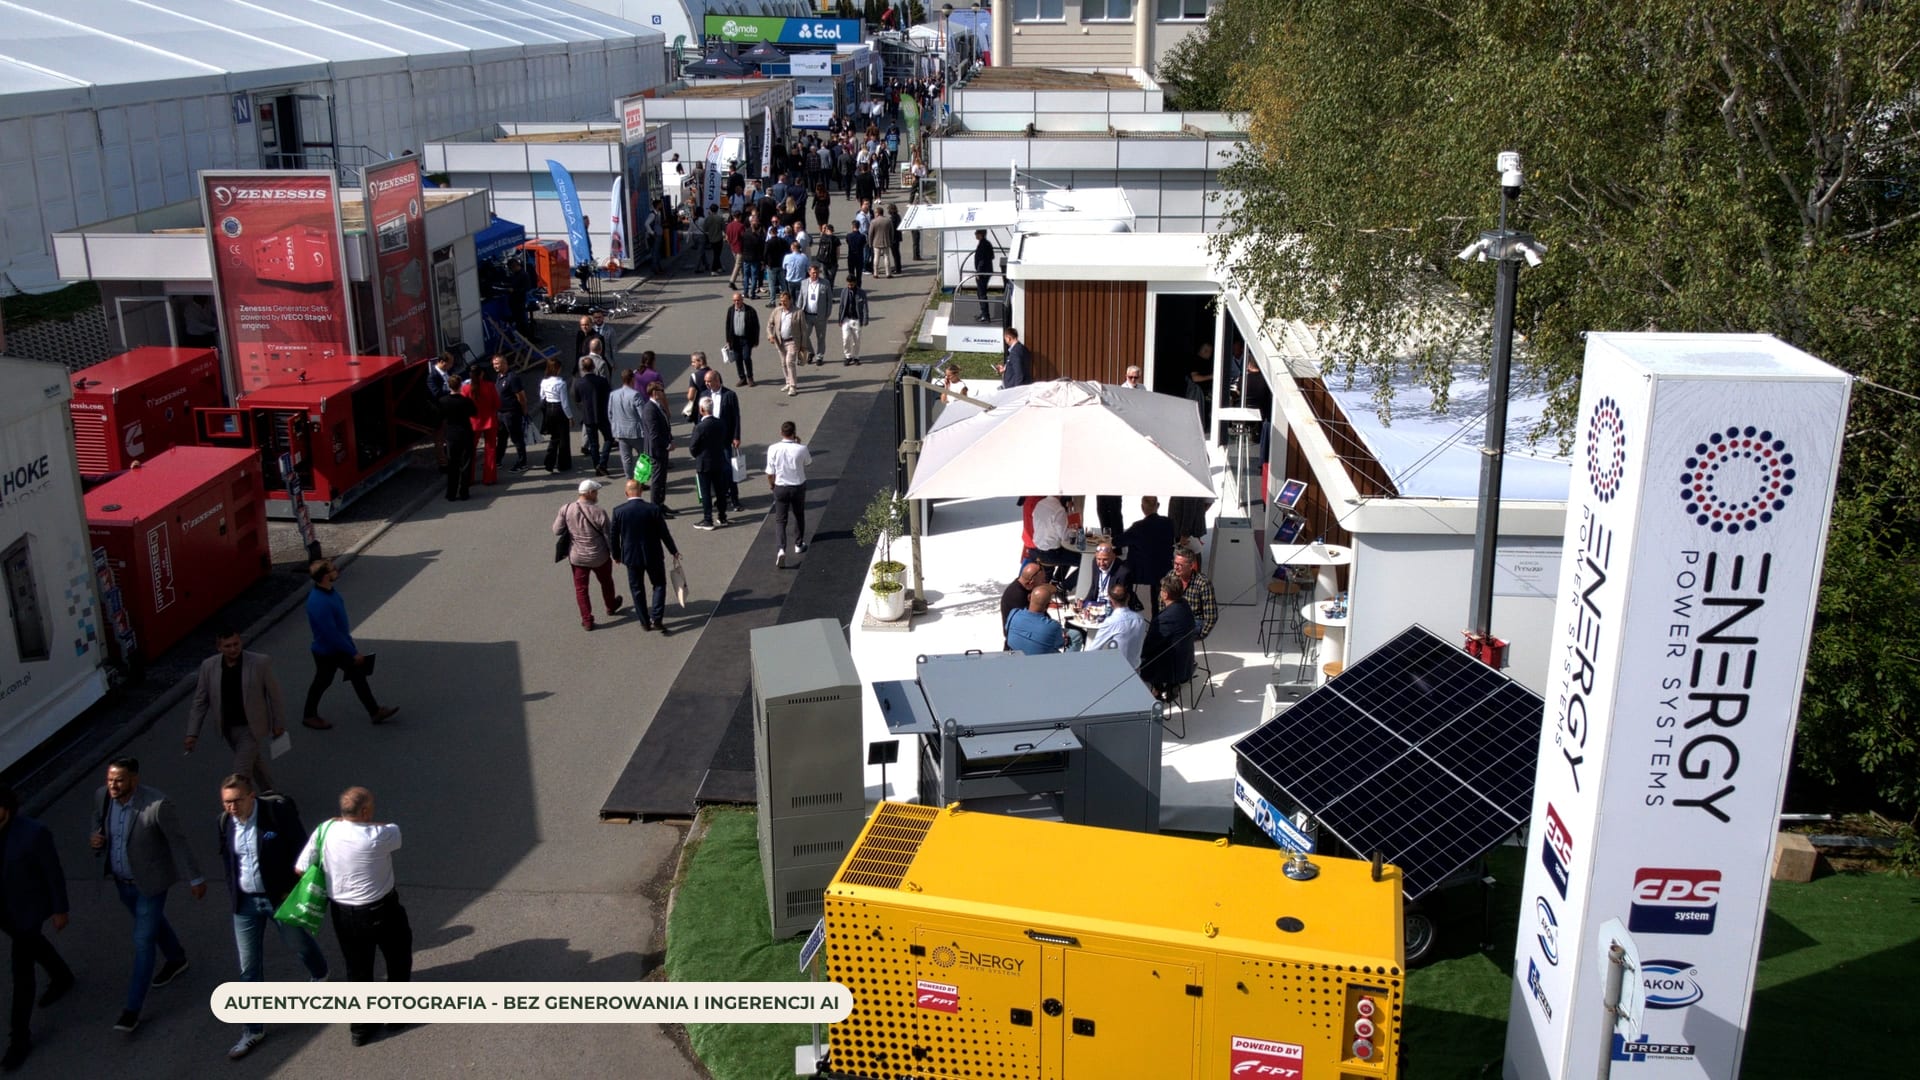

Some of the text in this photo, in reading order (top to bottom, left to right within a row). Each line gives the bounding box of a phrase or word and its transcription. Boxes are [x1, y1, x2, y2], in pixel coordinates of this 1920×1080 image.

[653, 16, 660, 24] G
[814, 25, 841, 39] Ecol
[237, 98, 248, 119] N
[378, 173, 416, 192] ZENESSIS
[708, 162, 717, 201] Electra
[237, 188, 327, 200] ZENESSIS
[240, 304, 329, 313] Zenessis Generator Sets
[240, 314, 332, 323] powered by IVECO Stage V
[242, 322, 270, 332] engines
[151, 543, 164, 609] Baudouin
[1554, 504, 1590, 747] POWER SYSTEMS
[1563, 513, 1612, 793] ENERGY
[1645, 550, 1700, 807] POWER SYSTEMS
[1672, 551, 1772, 824] ENERGY
[1545, 818, 1571, 866] EPS
[1634, 878, 1720, 904] EPS
[1674, 911, 1709, 922] system
[959, 950, 1024, 972] ENERGY
[959, 963, 1021, 977] POWER SYSTEMS
[919, 982, 946, 992] POWERED
[1643, 979, 1685, 991] AKON
[931, 997, 956, 1007] FPT
[1235, 1040, 1300, 1056] POWERED BY
[1628, 1044, 1690, 1054] PROFER
[1256, 1065, 1300, 1078] FPT
